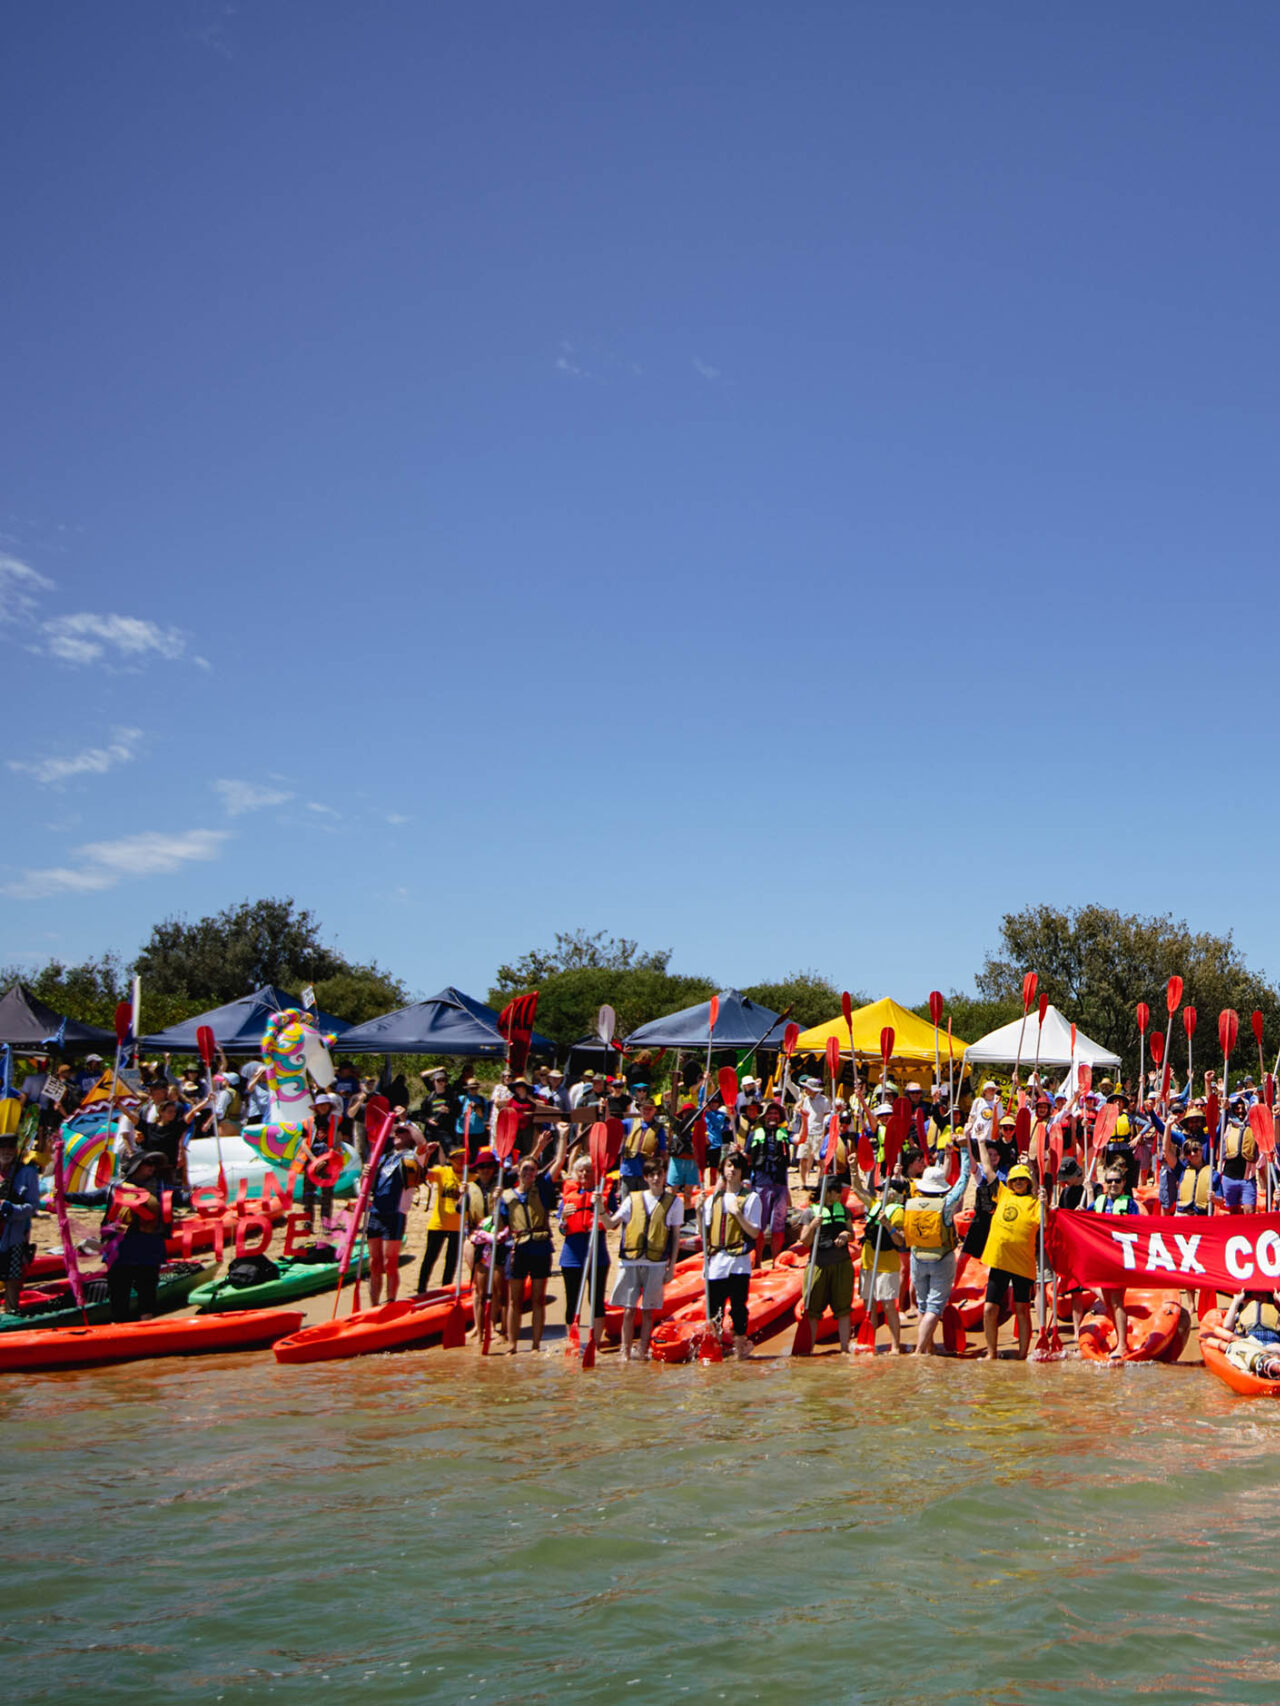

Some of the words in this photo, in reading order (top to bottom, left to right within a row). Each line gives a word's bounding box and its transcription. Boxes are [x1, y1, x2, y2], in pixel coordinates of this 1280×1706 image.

[107, 1148, 345, 1224] RISING
[179, 1212, 311, 1263] TIDE
[1111, 1231, 1206, 1274] TAX
